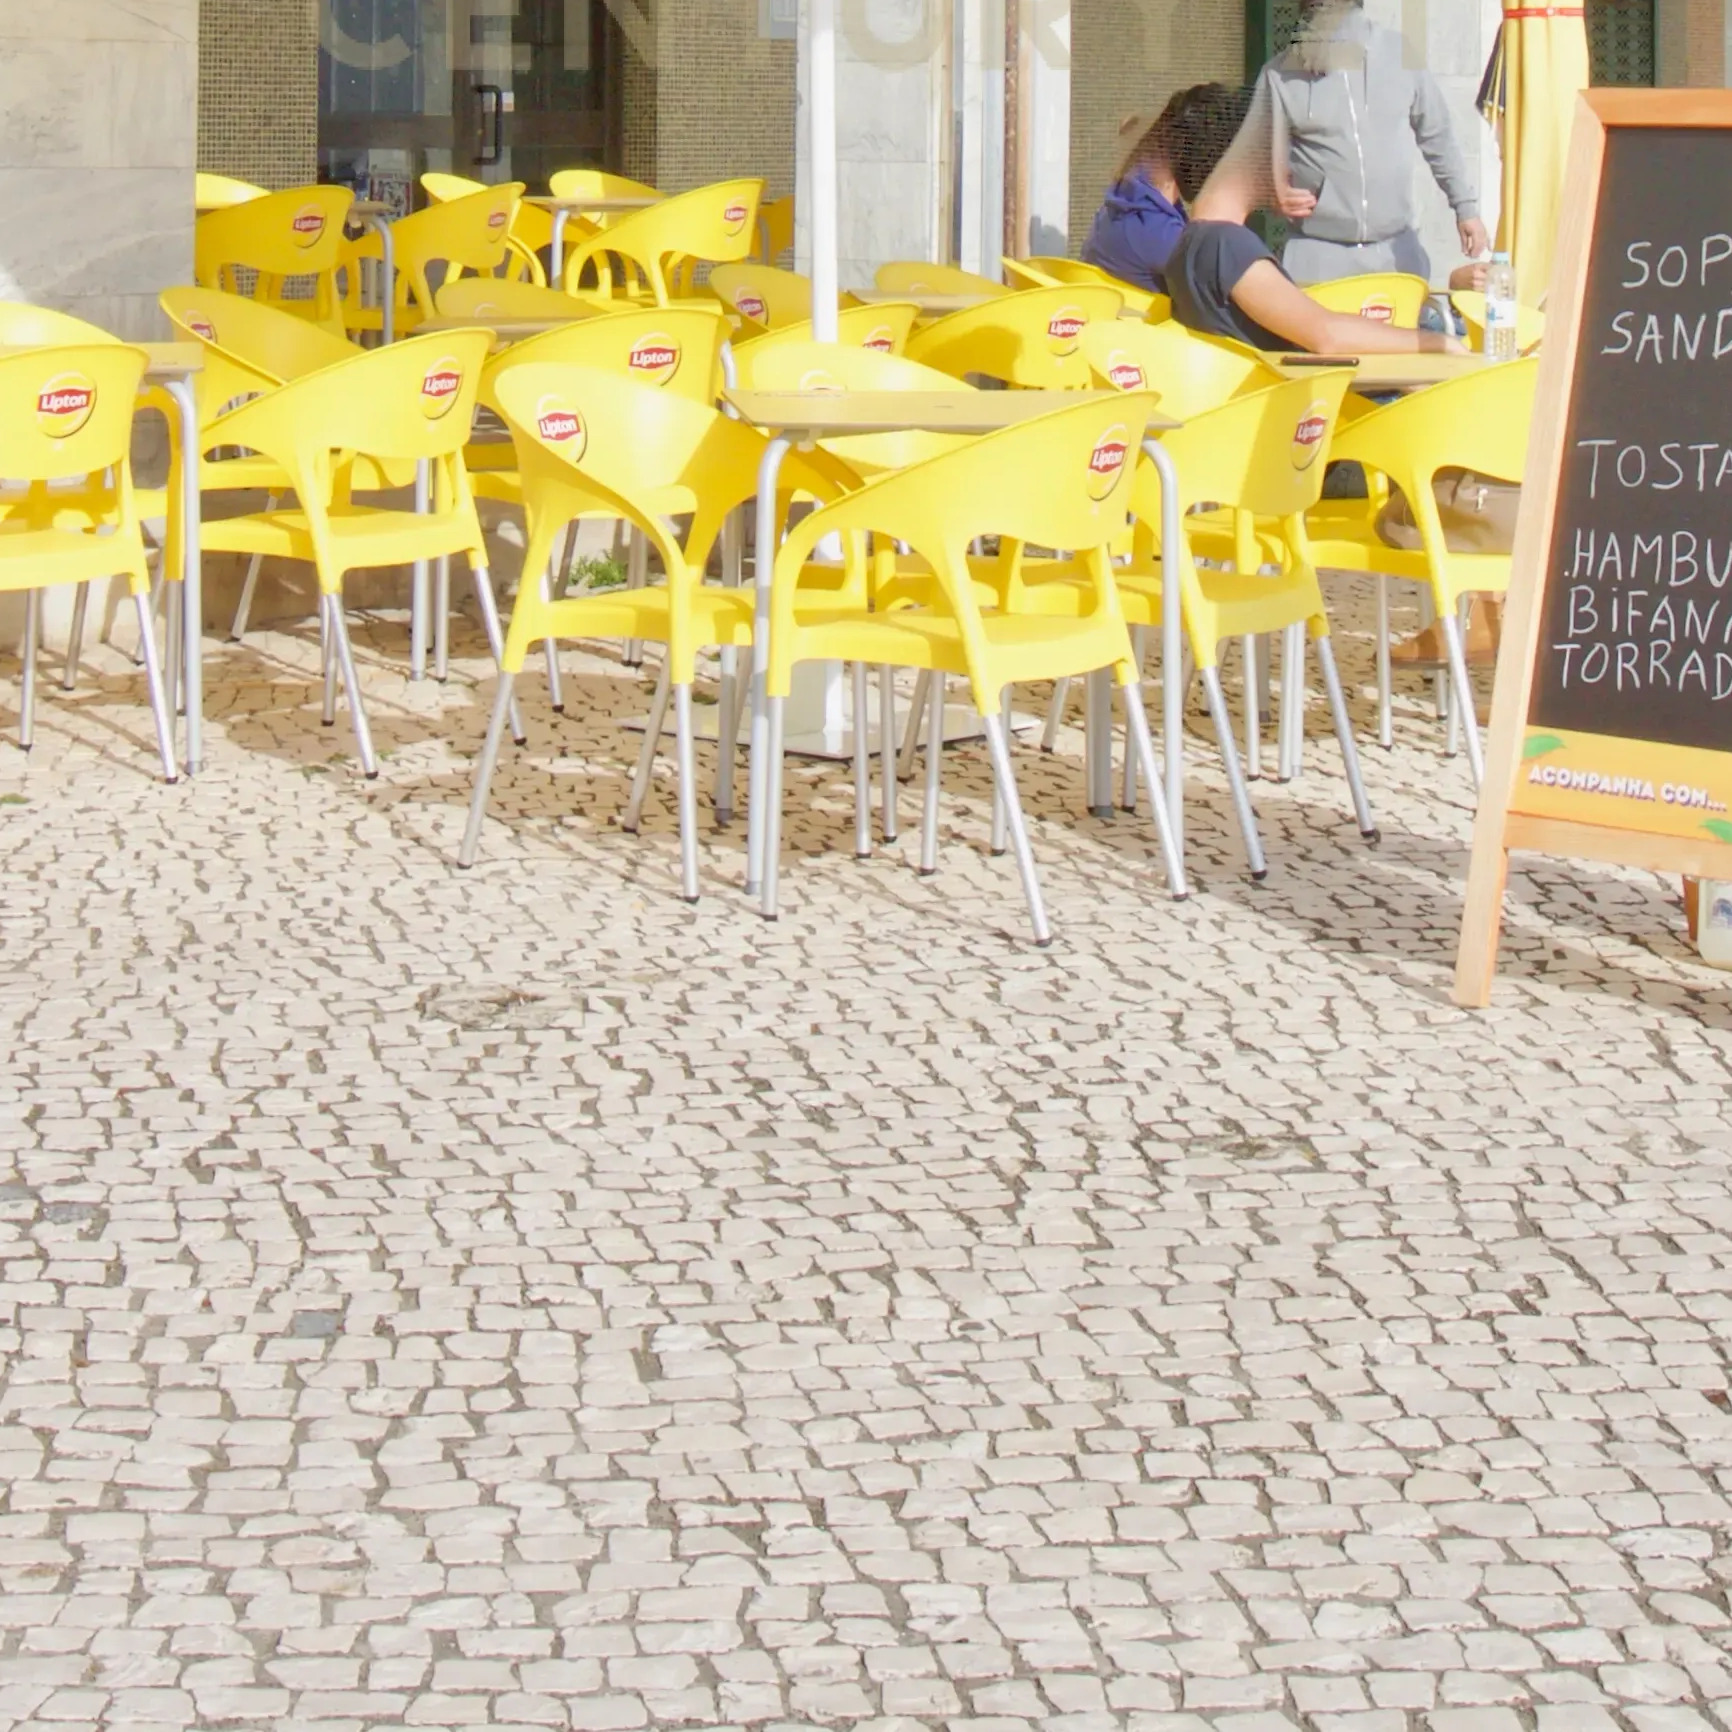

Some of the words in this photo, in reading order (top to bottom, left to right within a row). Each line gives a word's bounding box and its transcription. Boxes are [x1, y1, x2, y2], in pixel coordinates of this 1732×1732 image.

[632, 351, 673, 366] Lipton
[426, 376, 458, 393] Lipton
[42, 393, 86, 410] Lipton
[542, 419, 577, 436] Lipton
[1095, 449, 1124, 467] Lipton
[1528, 764, 1655, 801] ACOMPANHA
